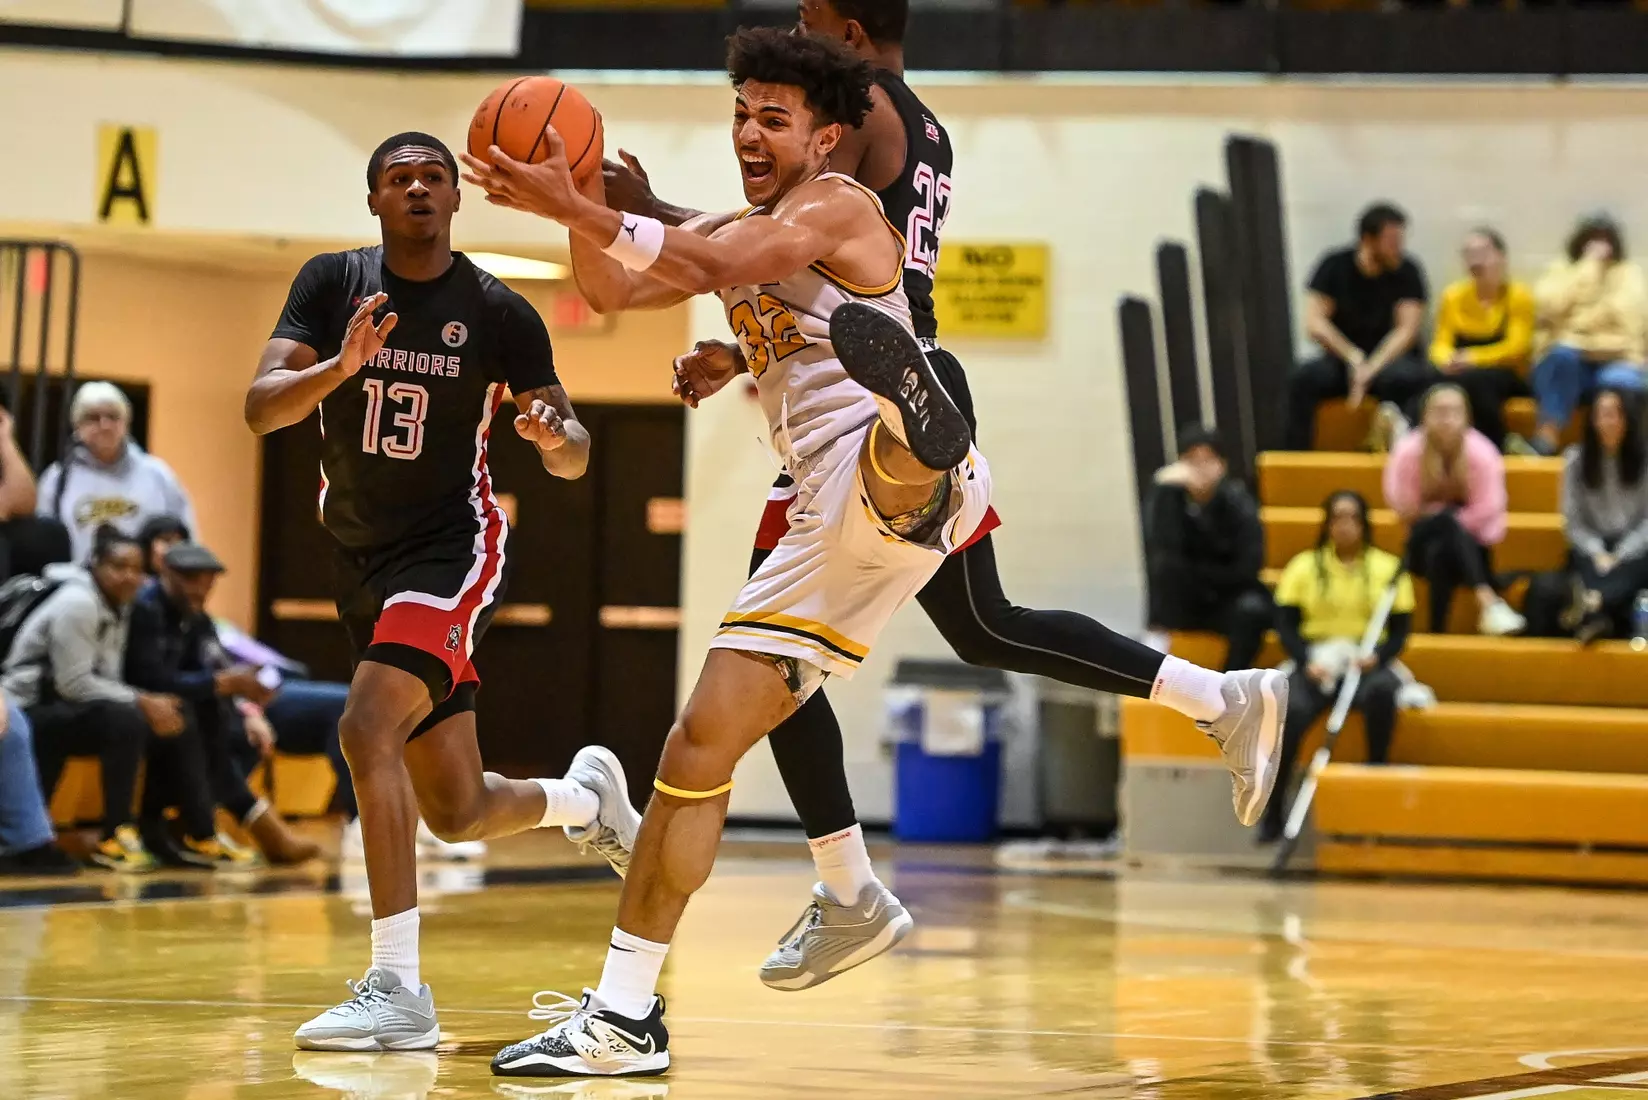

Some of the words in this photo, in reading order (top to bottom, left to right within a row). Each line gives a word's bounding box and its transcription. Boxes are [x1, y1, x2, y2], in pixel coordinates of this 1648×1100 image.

[98, 128, 150, 223] A
[730, 292, 816, 379] 32
[362, 378, 429, 461] 13
